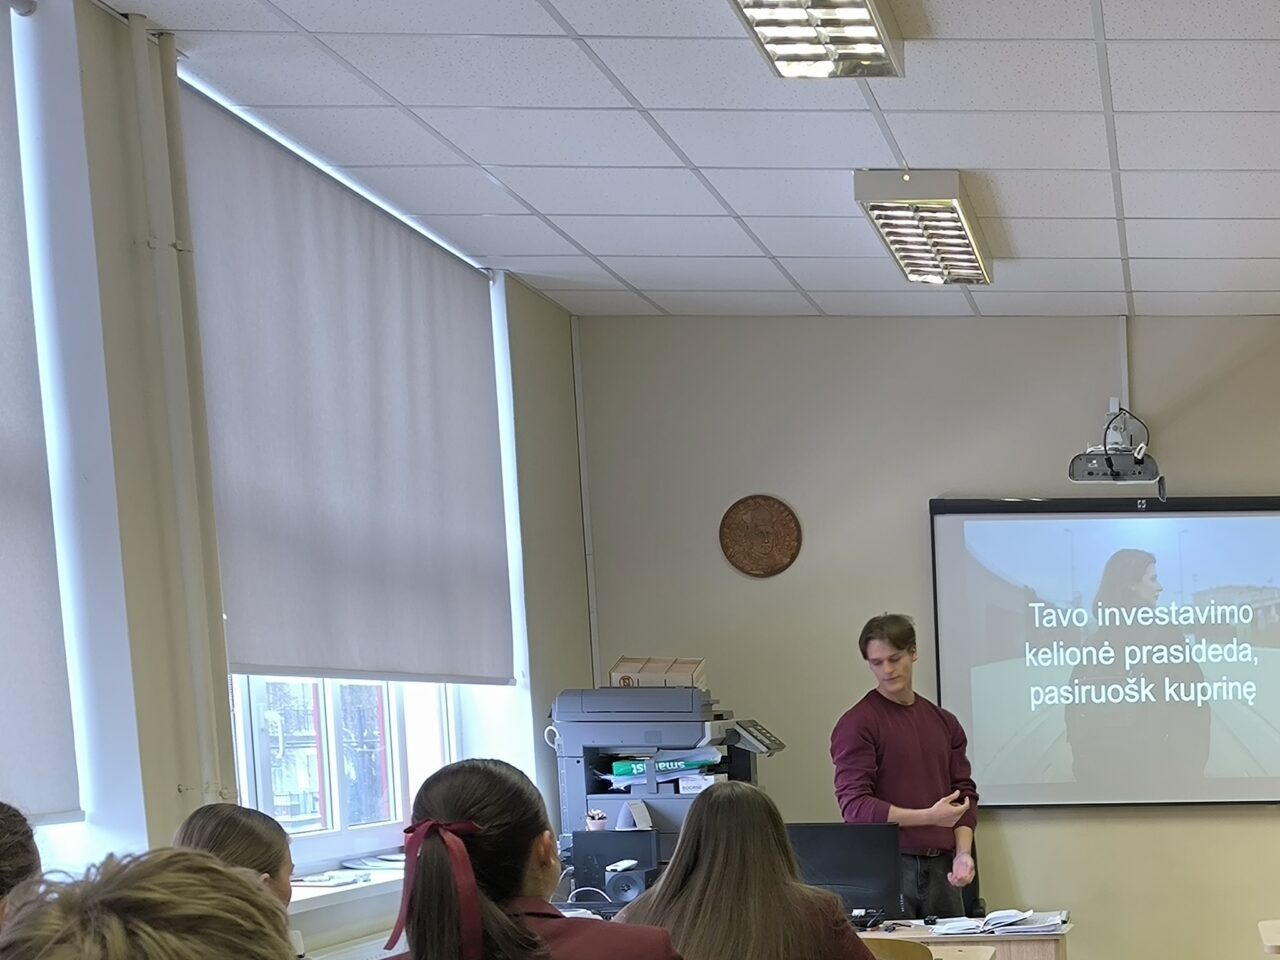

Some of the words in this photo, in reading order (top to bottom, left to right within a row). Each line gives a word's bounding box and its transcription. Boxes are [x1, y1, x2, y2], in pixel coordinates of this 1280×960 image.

[1029, 602, 1088, 627] Tavo
[1098, 600, 1254, 626] investavimo
[1025, 641, 1115, 667] kelionė
[1124, 638, 1258, 671] prasideda,
[1030, 676, 1156, 711] pasiruošk
[1164, 676, 1257, 707] kuprinę
